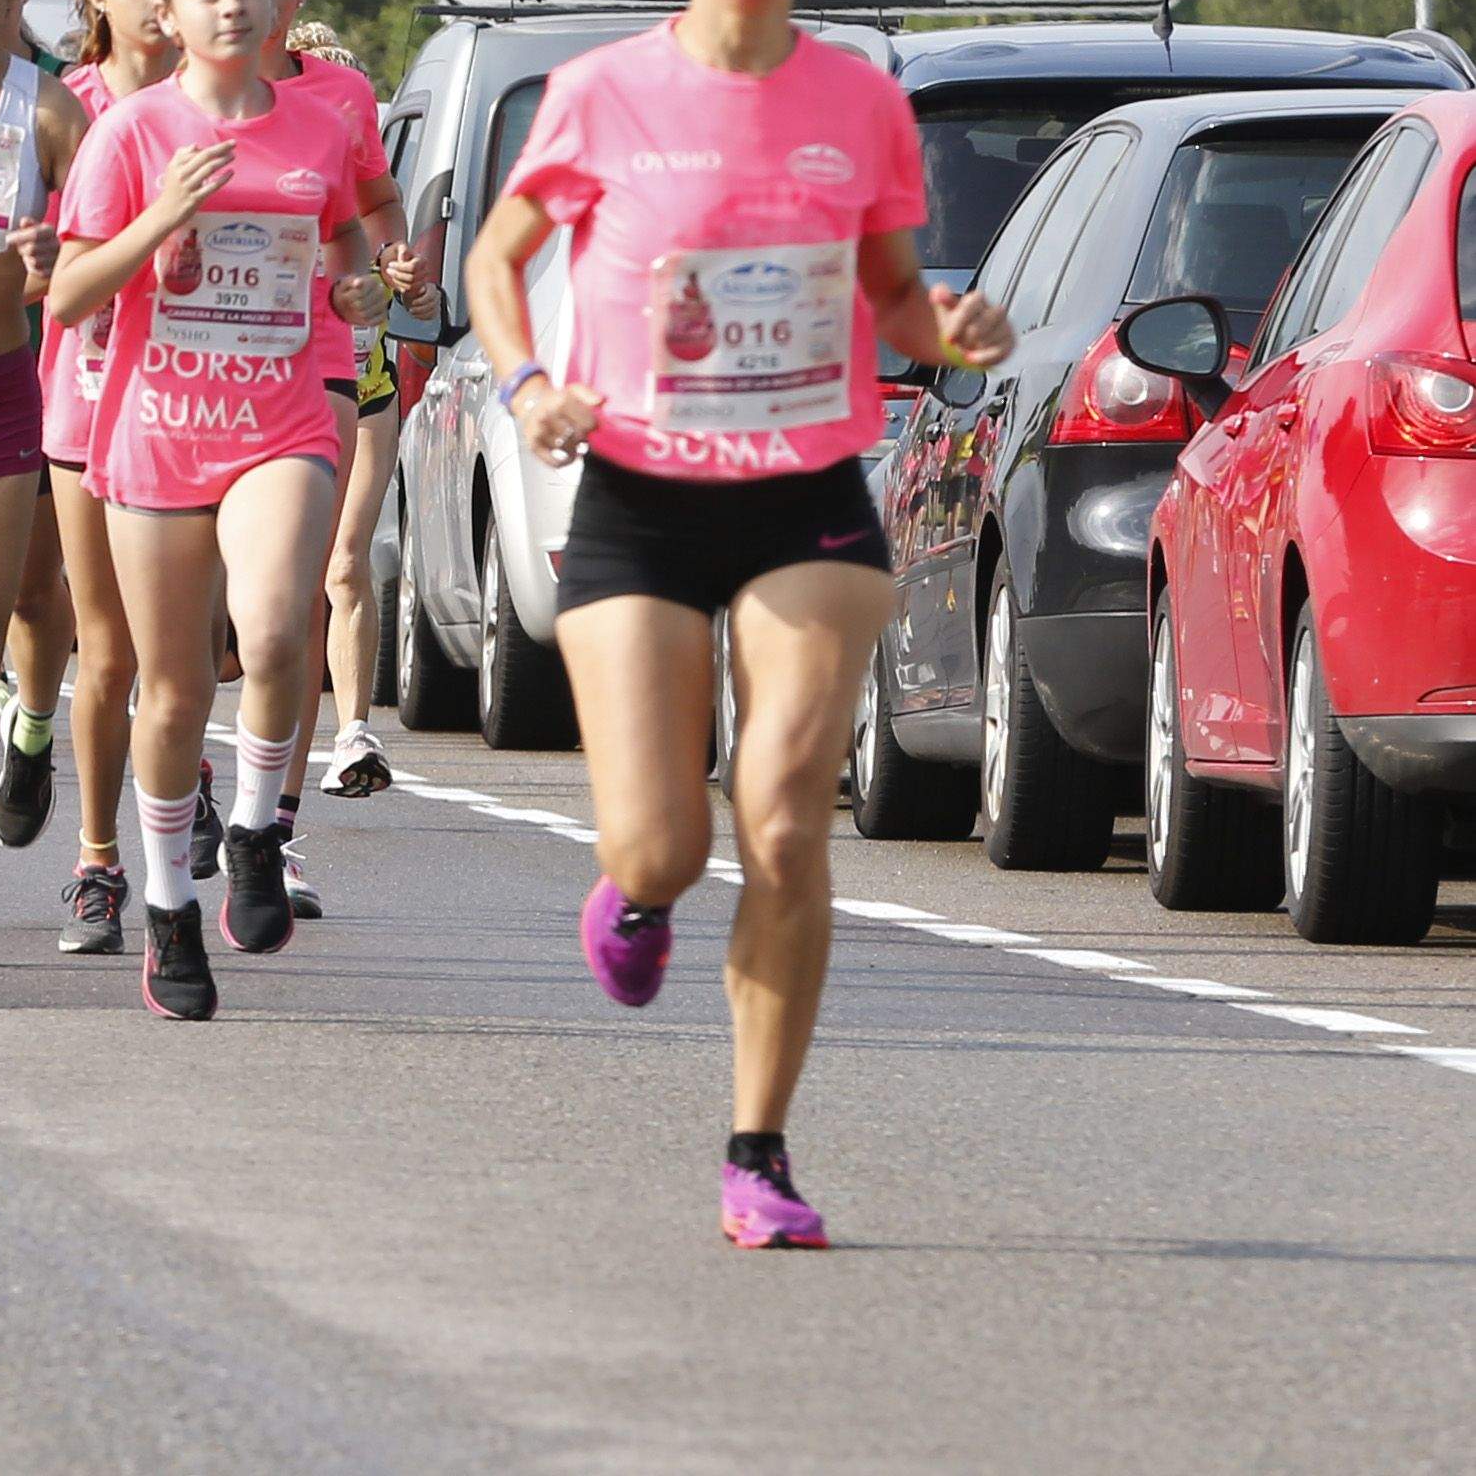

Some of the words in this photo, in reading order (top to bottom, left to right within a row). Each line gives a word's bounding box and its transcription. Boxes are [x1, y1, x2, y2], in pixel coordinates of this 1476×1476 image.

[206, 264, 260, 287] 016
[214, 292, 249, 306] 3970
[167, 307, 211, 320] CARRERA
[212, 310, 226, 321] DE
[226, 311, 240, 322] LA
[241, 311, 271, 323] MUJER
[723, 319, 793, 348] 016
[139, 387, 260, 431] SUMA
